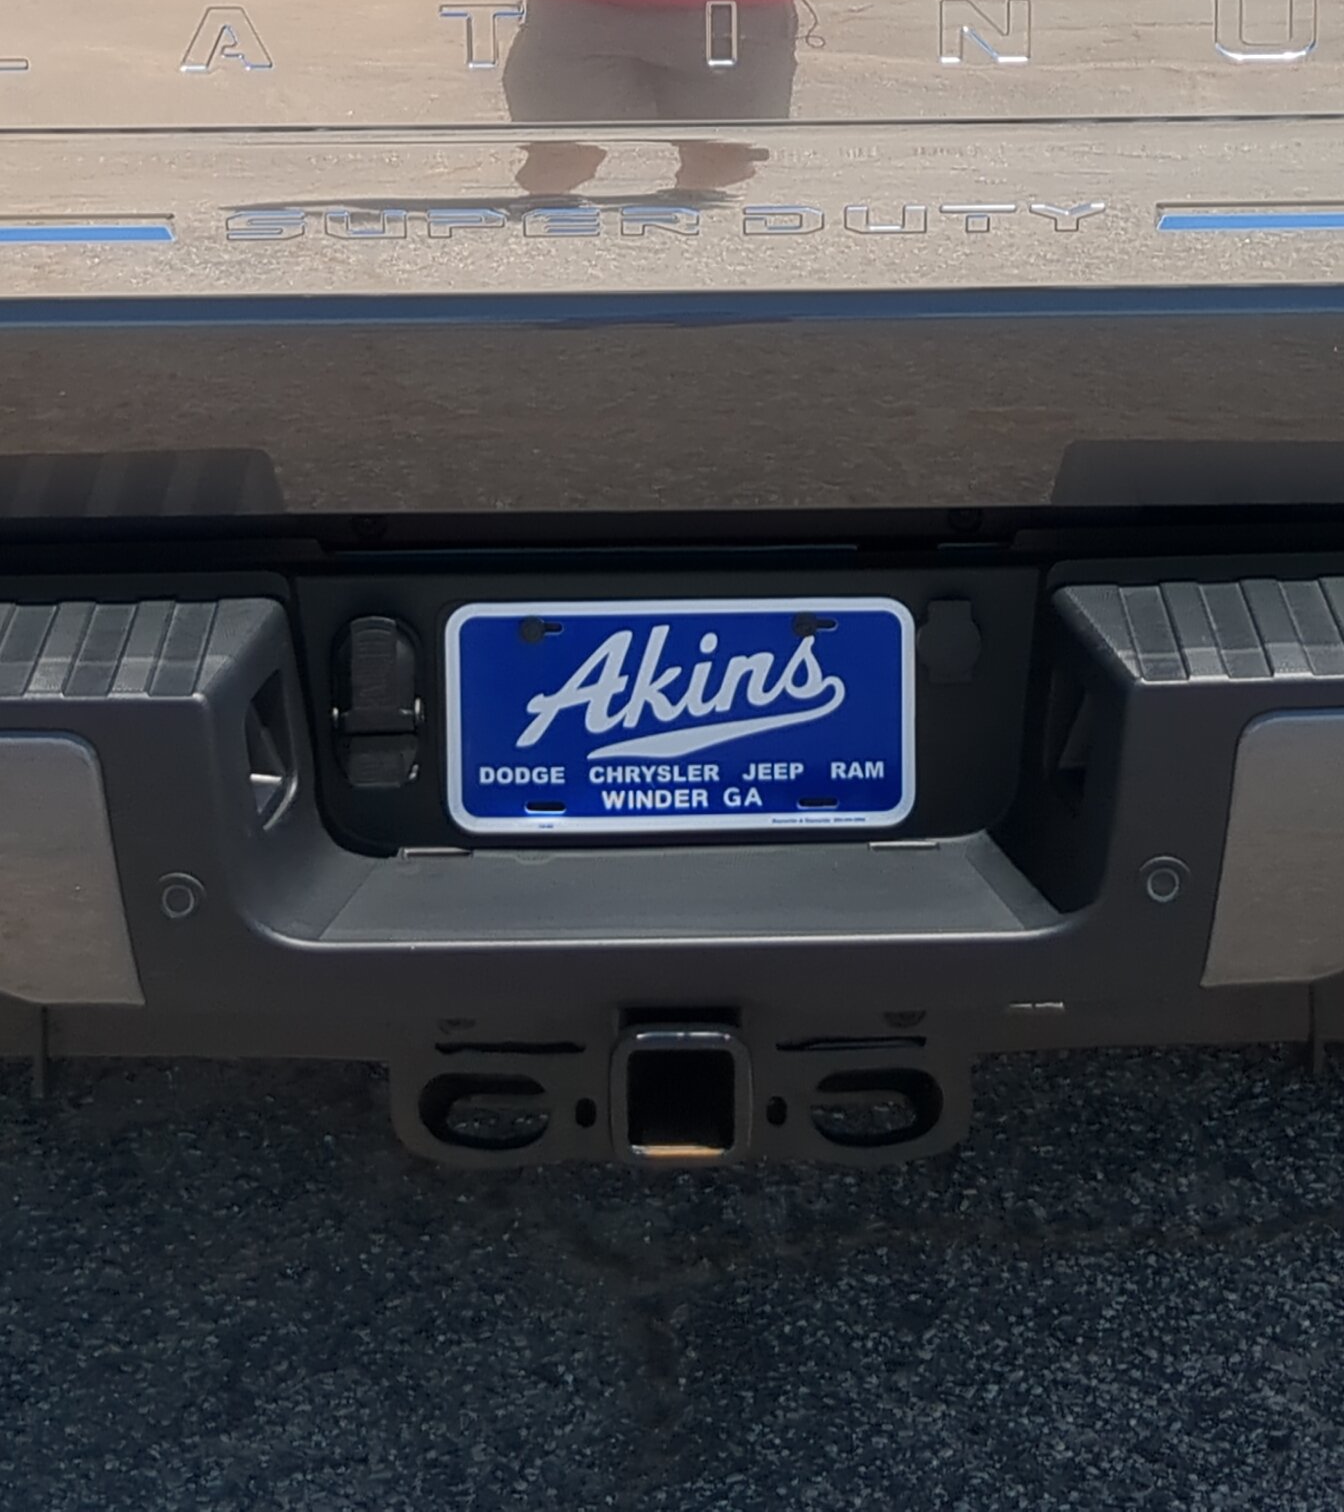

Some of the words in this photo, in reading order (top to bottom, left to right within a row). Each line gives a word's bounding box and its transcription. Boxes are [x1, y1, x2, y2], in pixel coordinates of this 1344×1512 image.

[224, 206, 700, 241] SUPER
[742, 202, 1106, 237] DUTY
[516, 624, 846, 760] Akins
[479, 766, 566, 785] DODGE
[588, 764, 720, 784] CHRYSLER
[742, 763, 805, 781] JEEP
[830, 761, 885, 779] RAM
[601, 789, 709, 810] WINDER
[723, 788, 763, 807] GA
